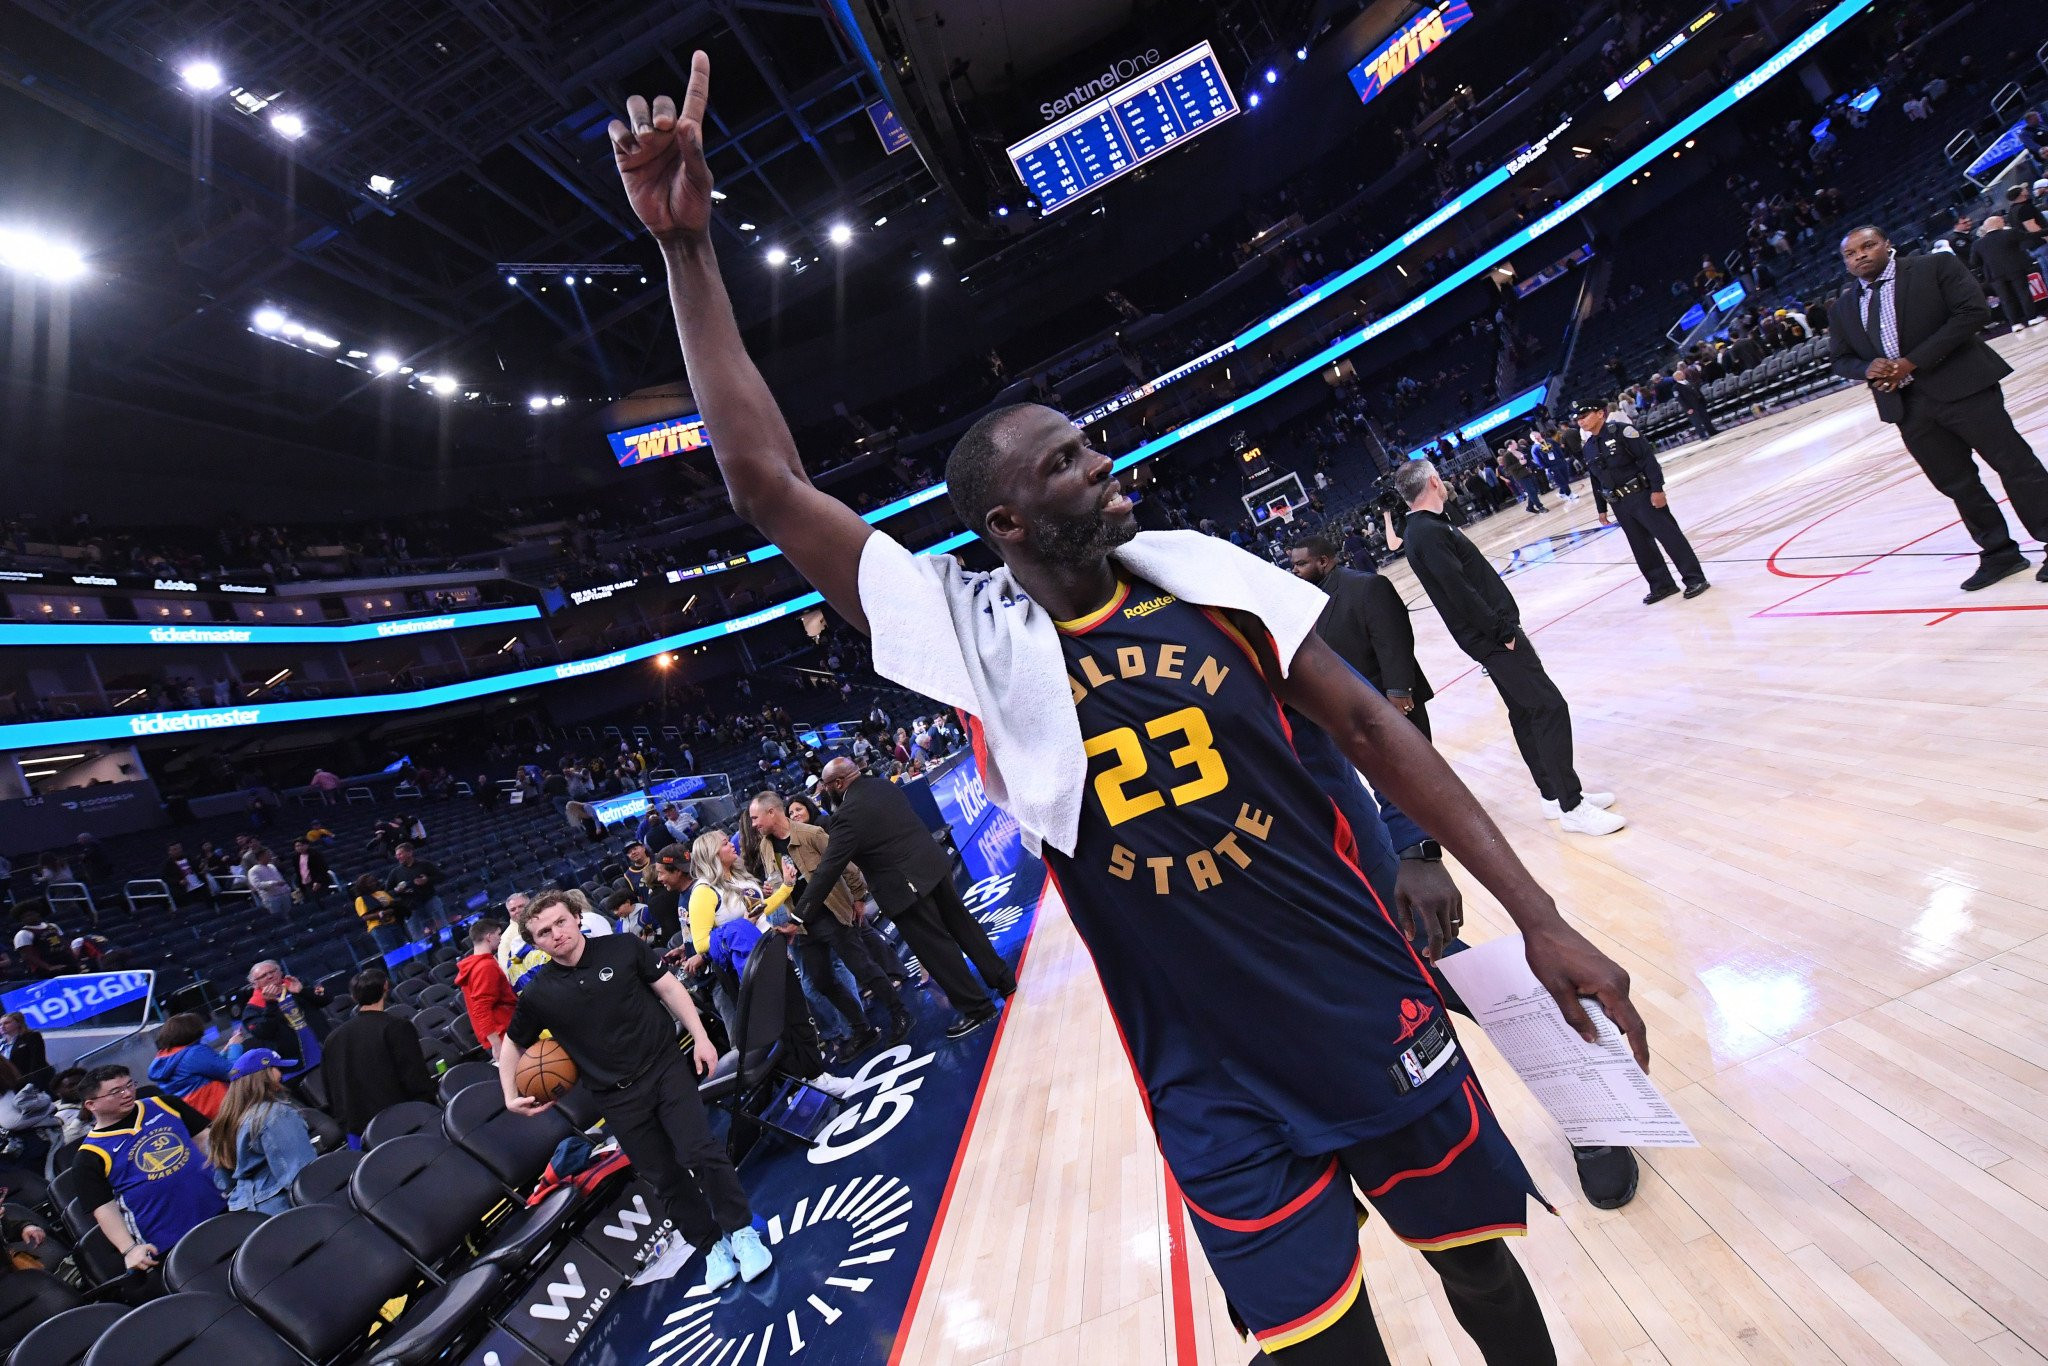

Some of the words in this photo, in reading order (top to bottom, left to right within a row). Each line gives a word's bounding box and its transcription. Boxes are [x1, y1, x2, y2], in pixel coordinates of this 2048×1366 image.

[1377, 15, 1448, 86] WIN
[1733, 22, 1829, 99] ticketmaster
[1040, 49, 1160, 121] SentinelOne
[1403, 201, 1461, 245] ticketmaster
[1529, 182, 1604, 240] ticketmaster
[1268, 293, 1321, 329] ticketmaster
[1362, 297, 1426, 341] ticketmaster
[1177, 405, 1235, 440] ticketmaster
[637, 428, 702, 459] WIN
[72, 576, 117, 586] verizon
[154, 579, 198, 591] Adobe
[219, 584, 267, 594] ticketmaster
[149, 627, 252, 643] ticketmaster
[376, 617, 456, 638] ticketmaster
[725, 605, 787, 633] ticketmaster
[555, 653, 628, 679] ticketmaster
[1069, 644, 1230, 706] LDEN
[129, 709, 261, 736] ticketmaster
[1082, 706, 1229, 827] 23
[596, 799, 646, 823] ketmaster
[1108, 802, 1274, 895] STATE
[151, 1135, 170, 1151] 30
[633, 1218, 673, 1262] WAYMO
[565, 1287, 611, 1345] WAYMO
